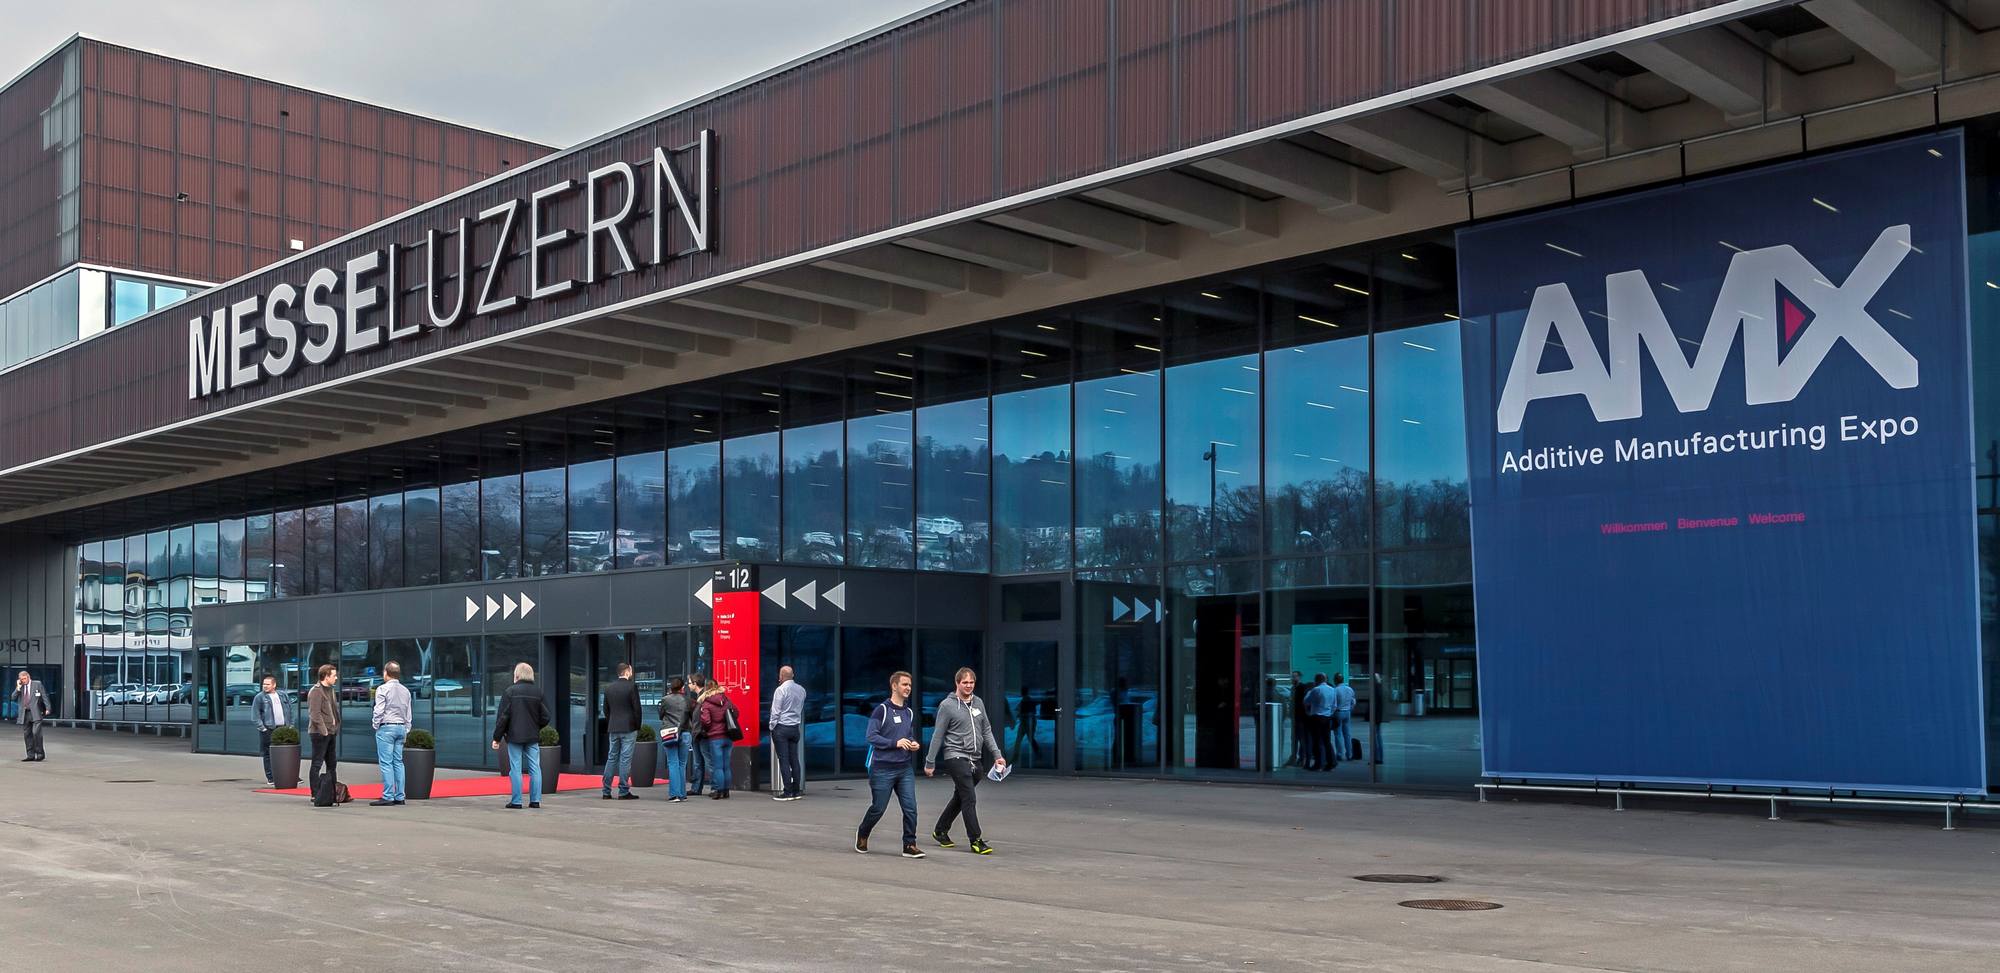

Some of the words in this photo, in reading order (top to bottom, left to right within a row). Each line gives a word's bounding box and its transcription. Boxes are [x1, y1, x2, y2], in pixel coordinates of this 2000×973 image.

[1497, 224, 1918, 433] AMX
[1501, 444, 1605, 474] Additive
[1615, 422, 1827, 464] Manufacturing
[1840, 414, 1919, 446] Expo
[1601, 521, 1667, 534] Willkommen
[1677, 516, 1738, 530] Bienvenue
[1748, 511, 1806, 525] Welcome
